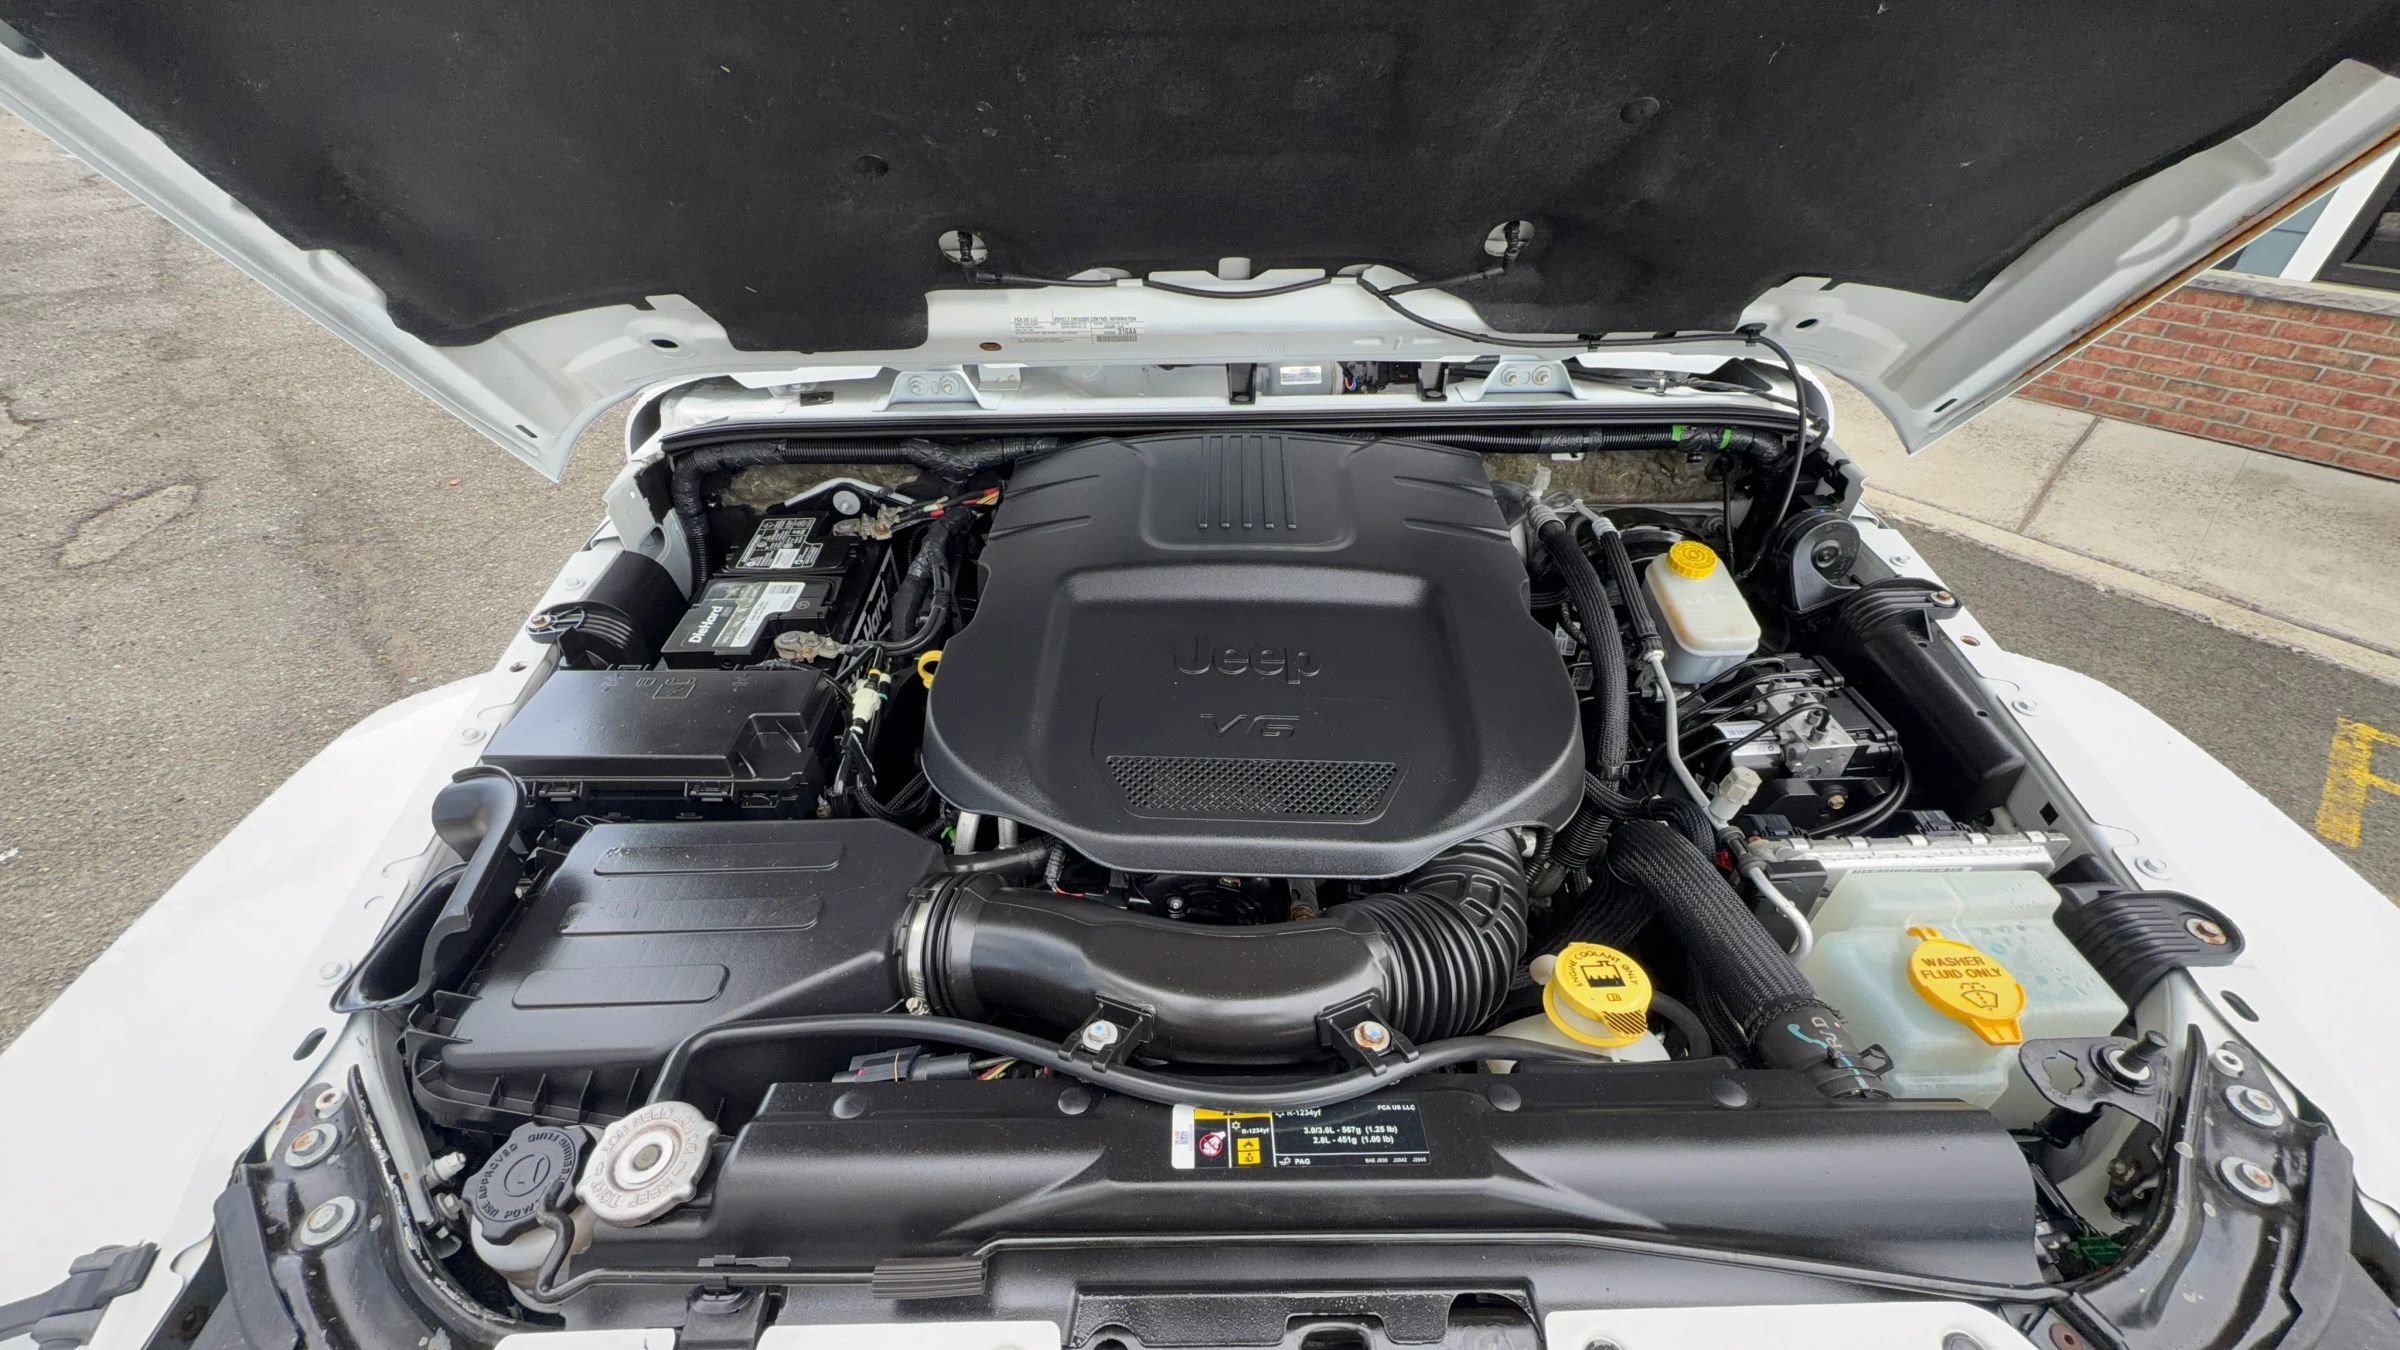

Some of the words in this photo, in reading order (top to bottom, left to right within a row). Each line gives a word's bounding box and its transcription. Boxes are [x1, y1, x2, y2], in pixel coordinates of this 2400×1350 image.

[688, 605, 724, 644] DieHard
[1174, 634, 1322, 685] Jeep
[1199, 713, 1301, 738] V6
[1574, 950, 1621, 963] COOLANT
[1921, 956, 1986, 968] WASHER
[1567, 959, 1583, 988] ENGINE
[1621, 963, 1639, 986] ONLY
[1920, 969, 1963, 979] FLUID
[1966, 967, 2002, 978] ONLY
[527, 1131, 560, 1143] FLUID
[1313, 1136, 1331, 1144] 2.8L
[1337, 1136, 1357, 1145] 451g
[1361, 1136, 1381, 1145] (1.00
[1382, 1136, 1394, 1144] lb)
[1386, 1126, 1398, 1135] lb)
[557, 1138, 573, 1183] TEERING
[478, 1143, 518, 1200] APPROVED
[626, 1177, 673, 1208] KEEP
[480, 1200, 500, 1218] USE
[504, 1201, 536, 1220] POW
